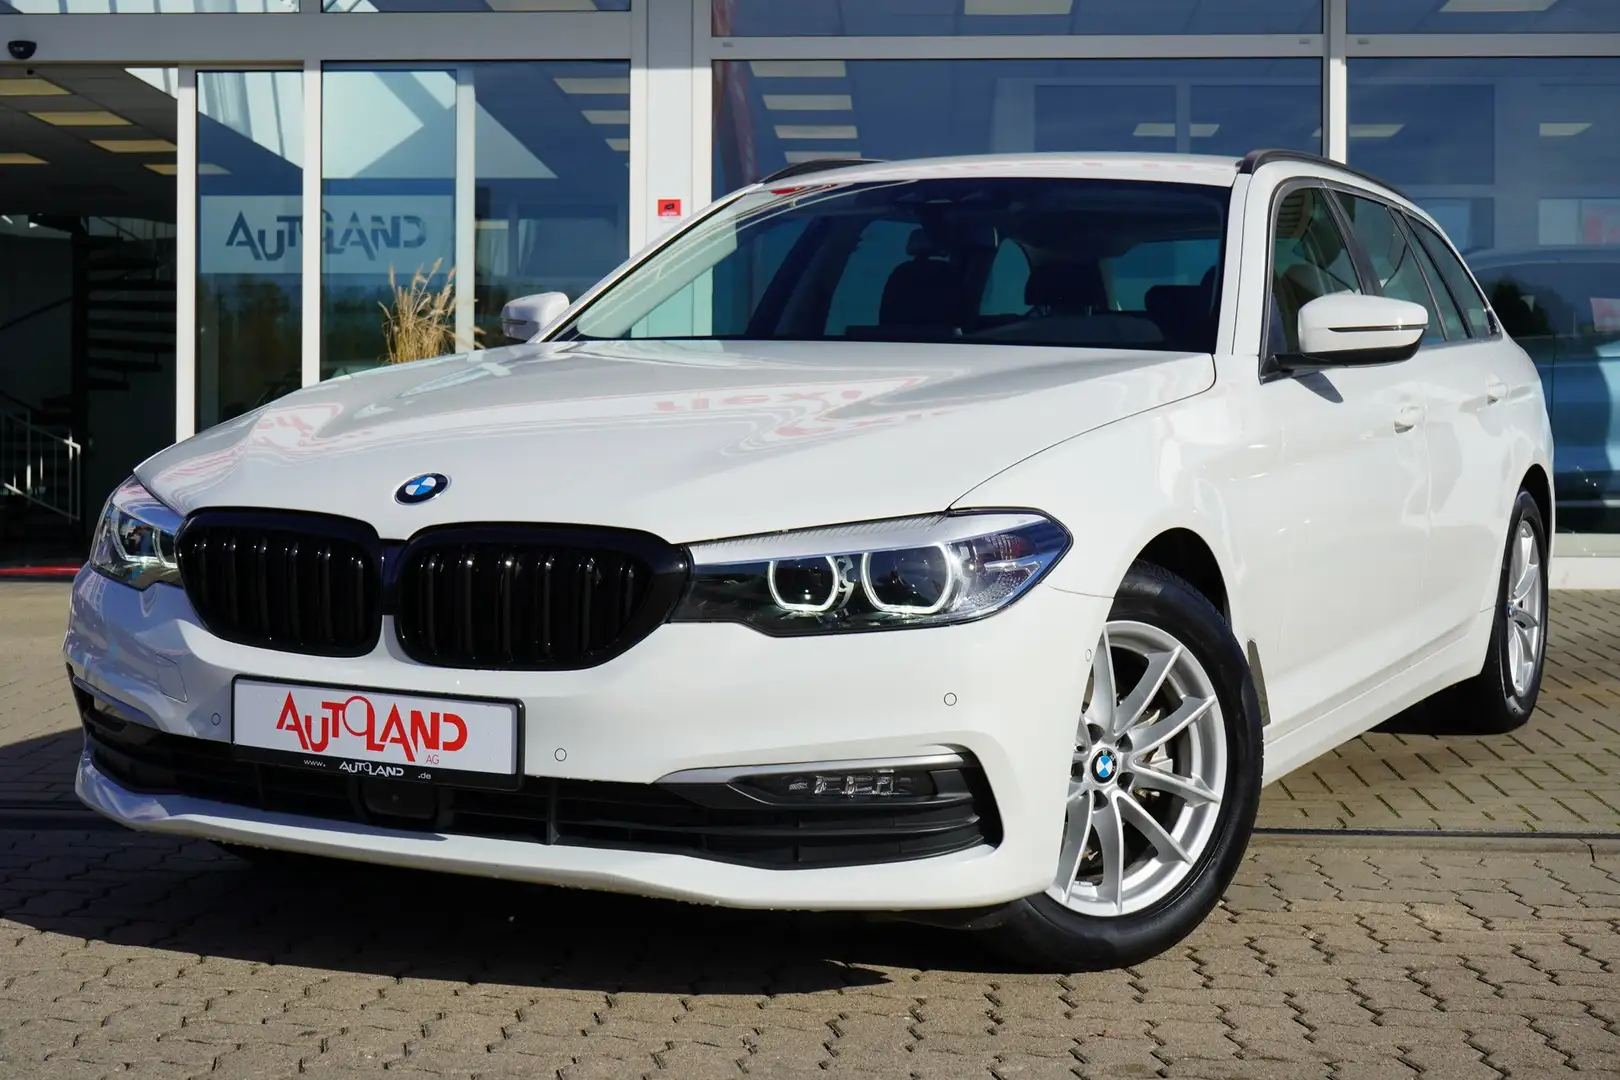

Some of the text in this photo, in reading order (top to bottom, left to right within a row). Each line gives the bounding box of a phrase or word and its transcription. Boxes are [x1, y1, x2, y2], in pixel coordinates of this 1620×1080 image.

[276, 691, 468, 762] AUTOLAND
[303, 759, 432, 781] www. AUTOLAND .de
[426, 753, 440, 765] AG
